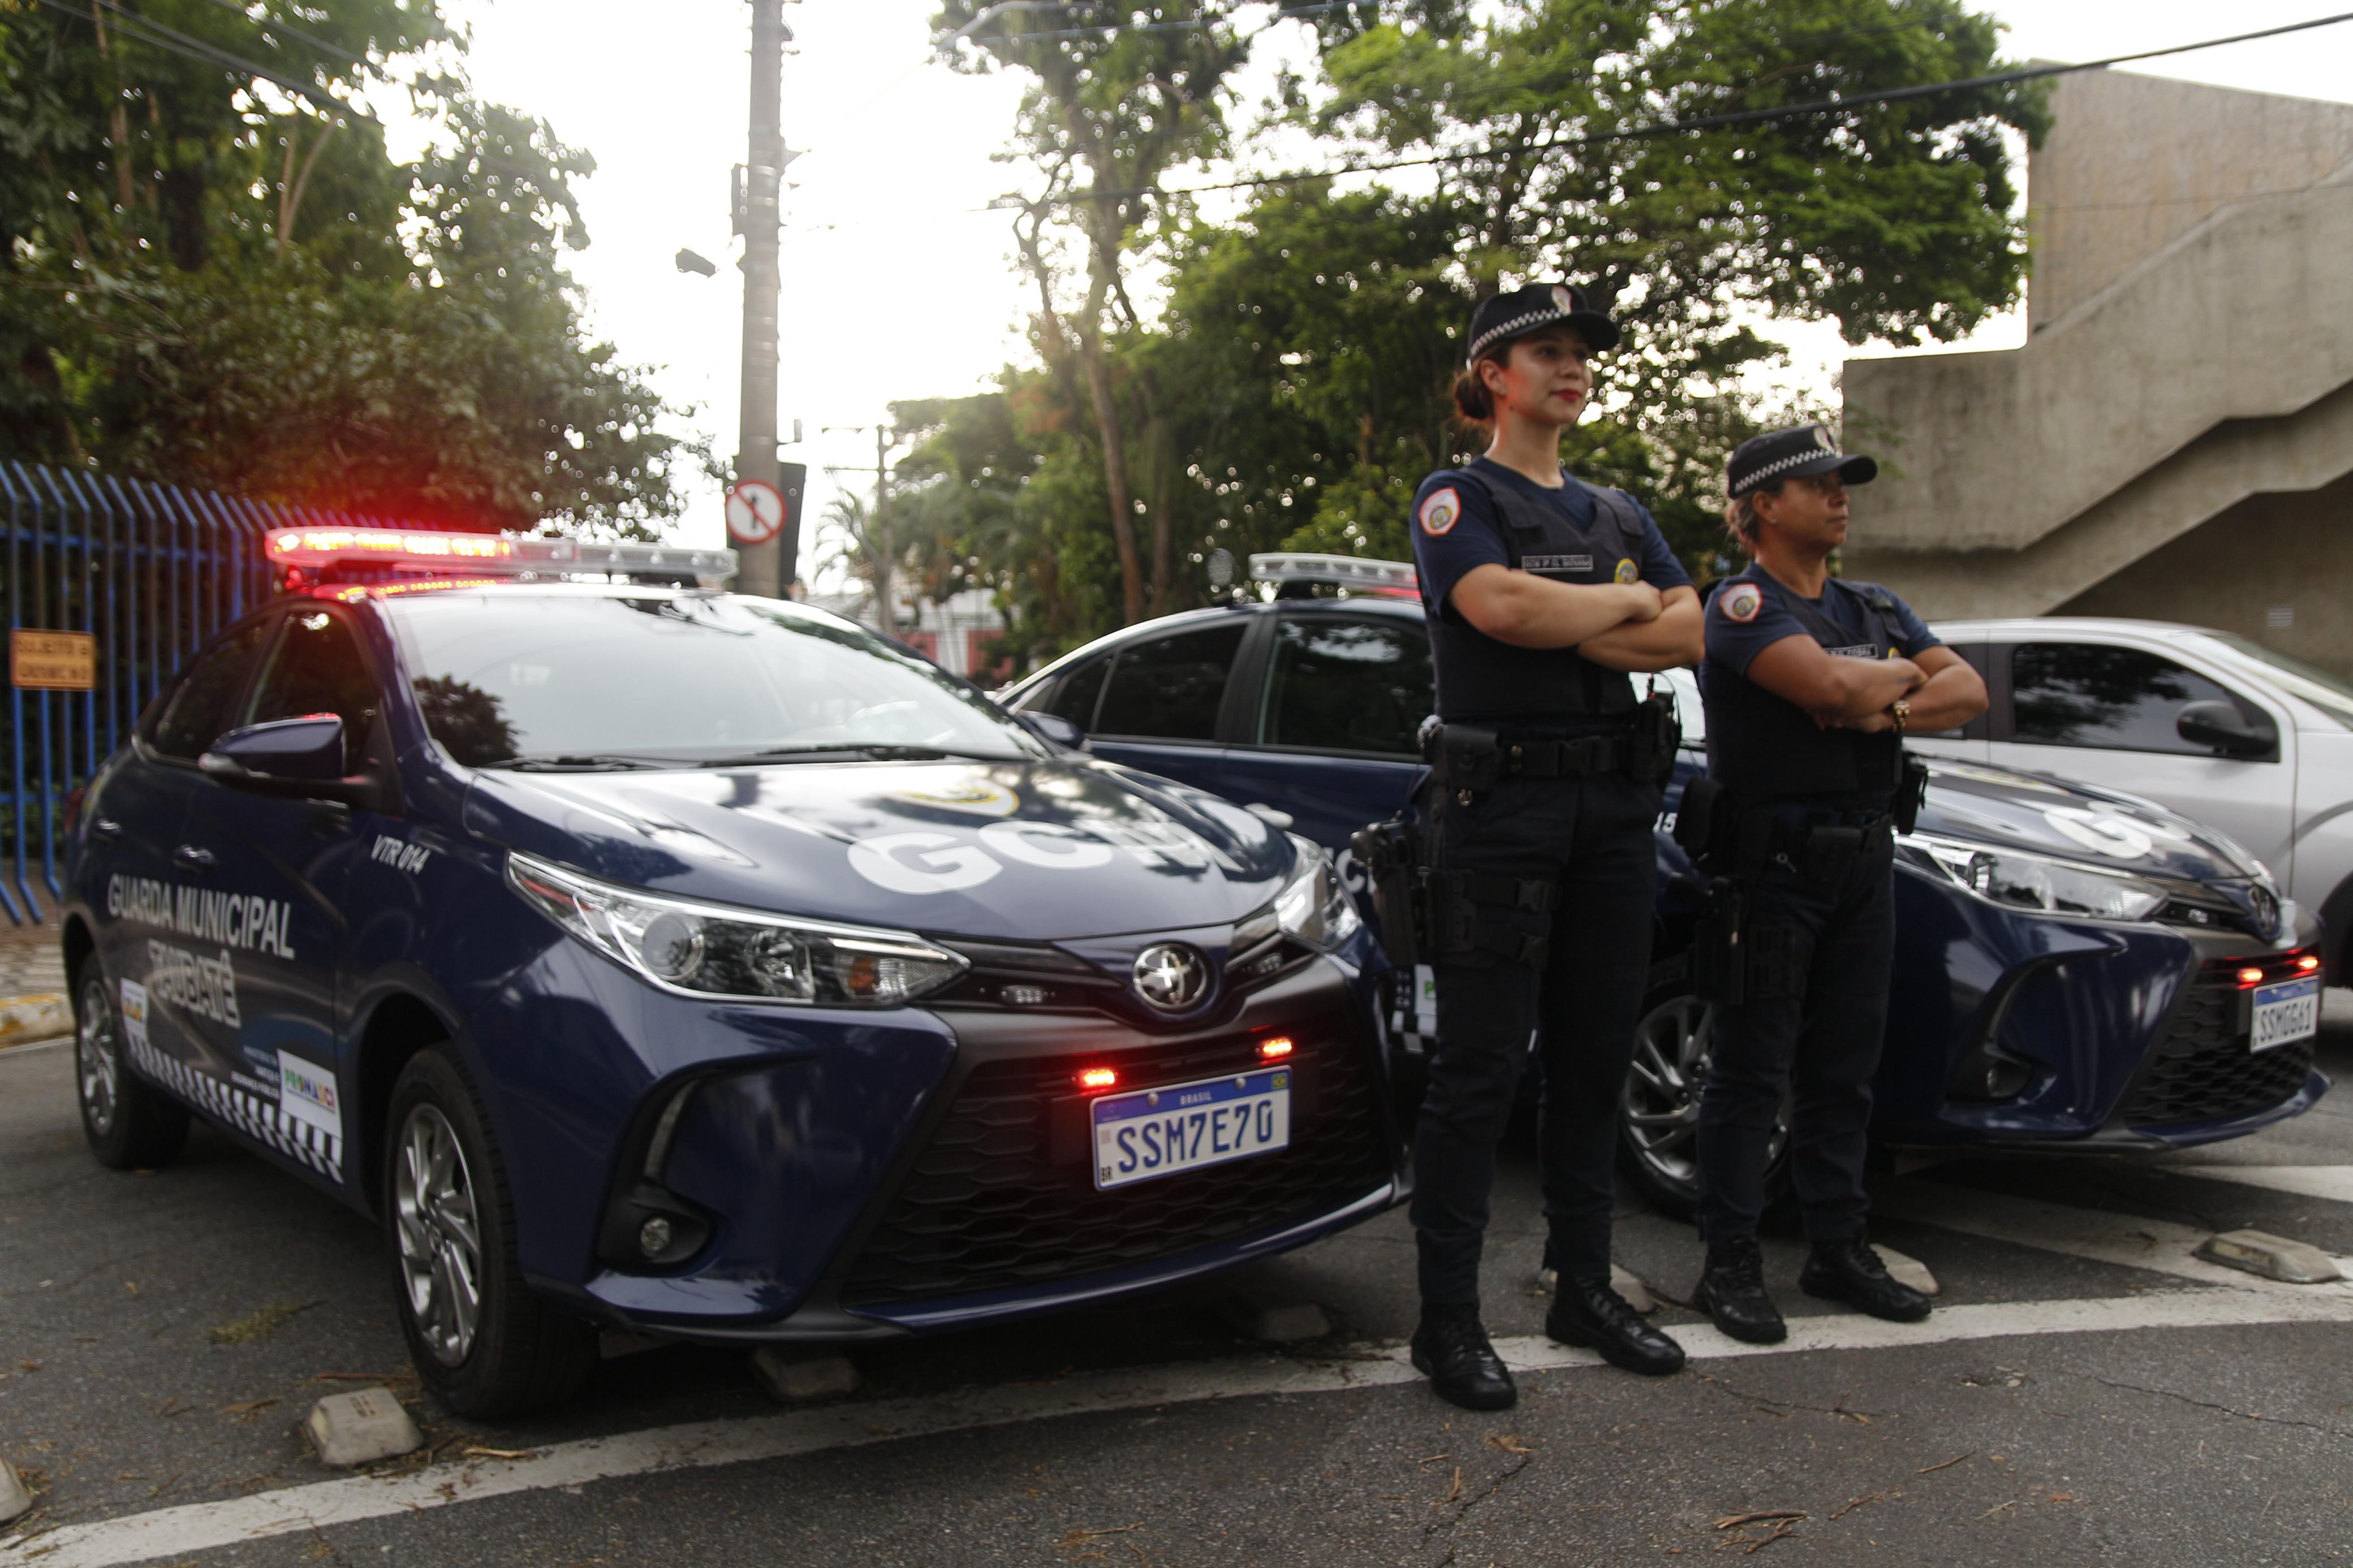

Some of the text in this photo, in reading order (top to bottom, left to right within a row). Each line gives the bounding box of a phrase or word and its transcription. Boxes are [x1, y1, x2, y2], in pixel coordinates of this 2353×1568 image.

[371, 834, 432, 875] VTR 014
[107, 873, 296, 960] GUARDA MUNICIPAL
[1180, 1091, 1213, 1106] BRASIL
[1117, 1098, 1273, 1173] SSM7E70
